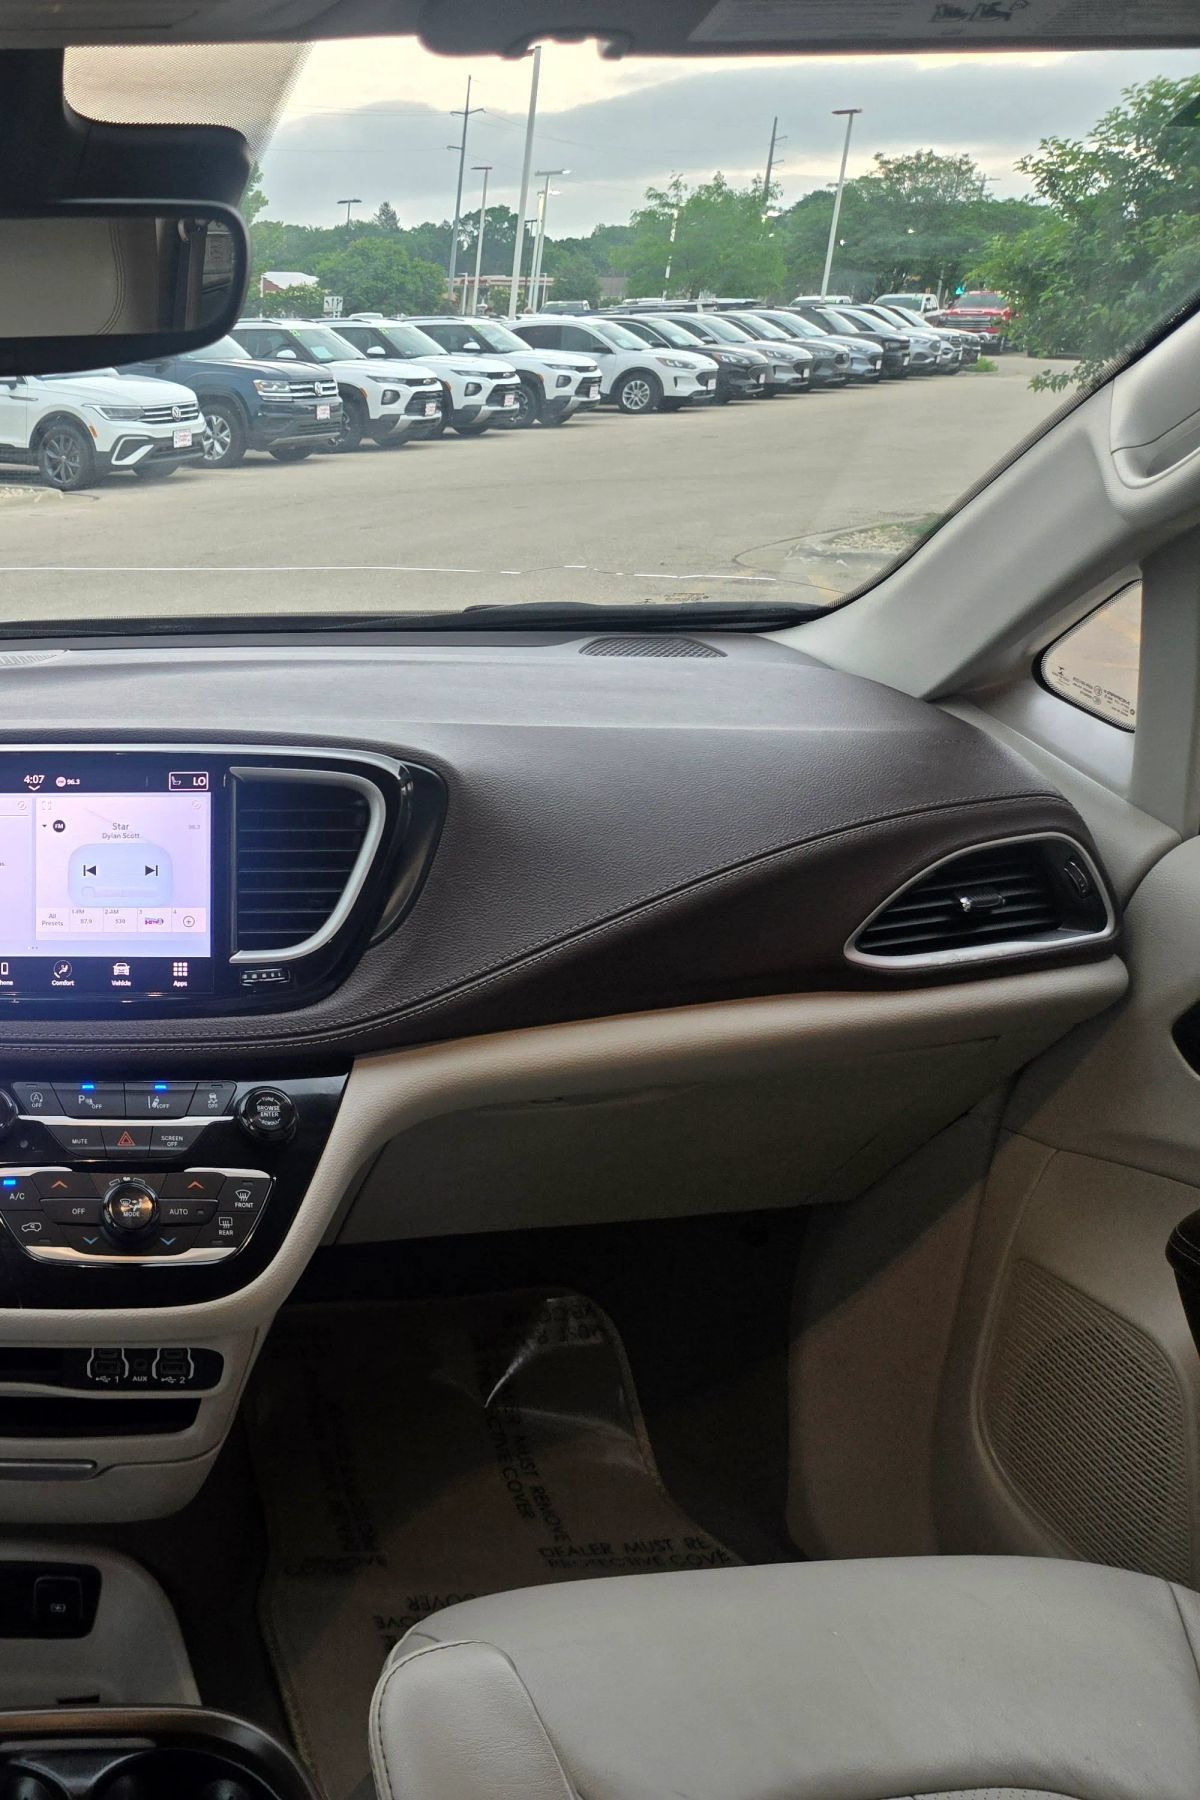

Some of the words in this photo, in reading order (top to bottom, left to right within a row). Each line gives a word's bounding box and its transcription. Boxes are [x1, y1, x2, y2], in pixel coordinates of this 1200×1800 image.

[24, 775, 45, 784] 4:07
[193, 777, 206, 786] LO
[112, 823, 129, 831] Star
[102, 832, 121, 841] Dylan
[9, 1192, 25, 1200] A/C
[539, 1543, 611, 1558] DEALER
[624, 1538, 671, 1553] MUST
